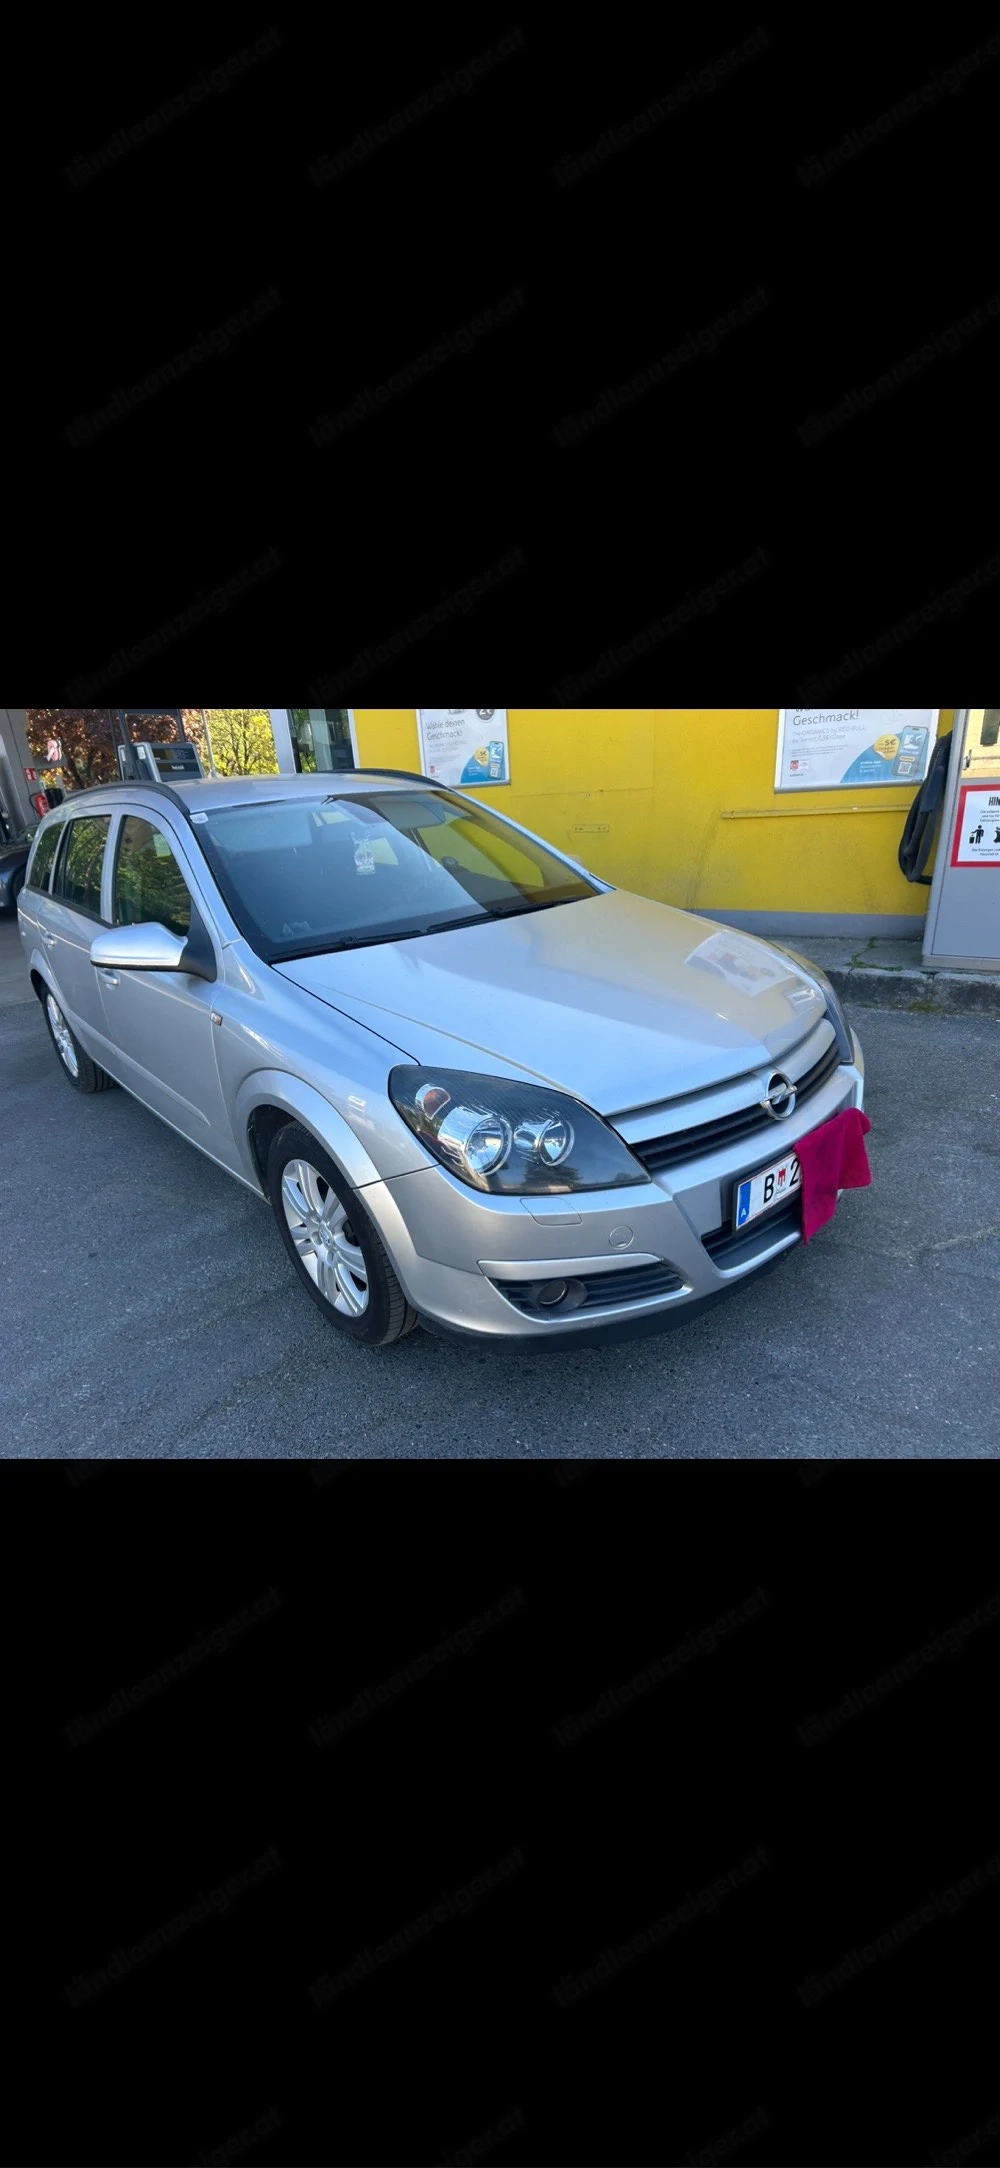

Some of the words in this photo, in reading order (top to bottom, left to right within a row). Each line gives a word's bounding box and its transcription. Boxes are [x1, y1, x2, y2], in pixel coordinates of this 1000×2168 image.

[793, 710, 859, 726] Geschmack!
[764, 1173, 775, 1203] B
[789, 1158, 800, 1187] 2
[741, 1208, 747, 1217] A
